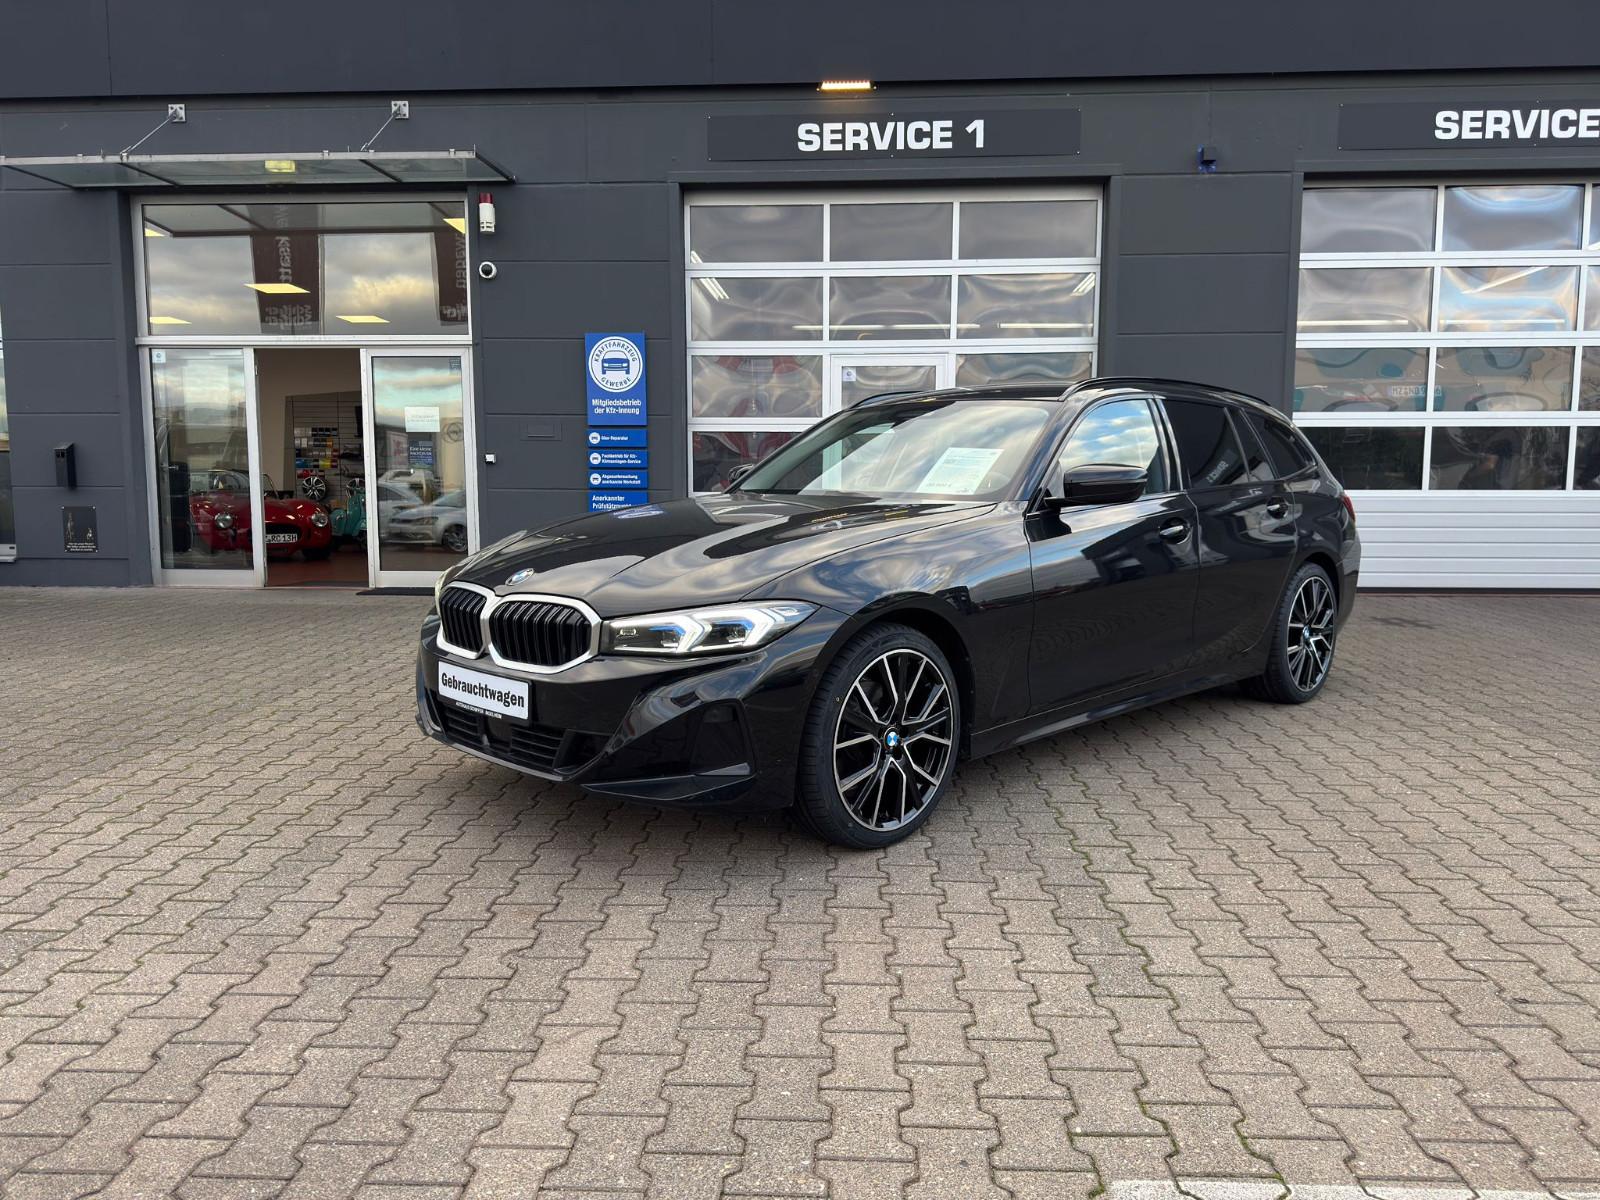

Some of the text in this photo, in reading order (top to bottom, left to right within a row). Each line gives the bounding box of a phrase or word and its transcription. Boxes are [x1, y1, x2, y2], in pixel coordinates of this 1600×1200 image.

[797, 119, 985, 152] SERVICE 1
[1435, 108, 1600, 140] SERVICE
[594, 342, 638, 362] KRAFTFAHRZEUG
[601, 376, 632, 387] GEWERBE
[592, 399, 641, 407] Mitgliedsbetrieb
[441, 672, 525, 708] Gebrauchtwagen
